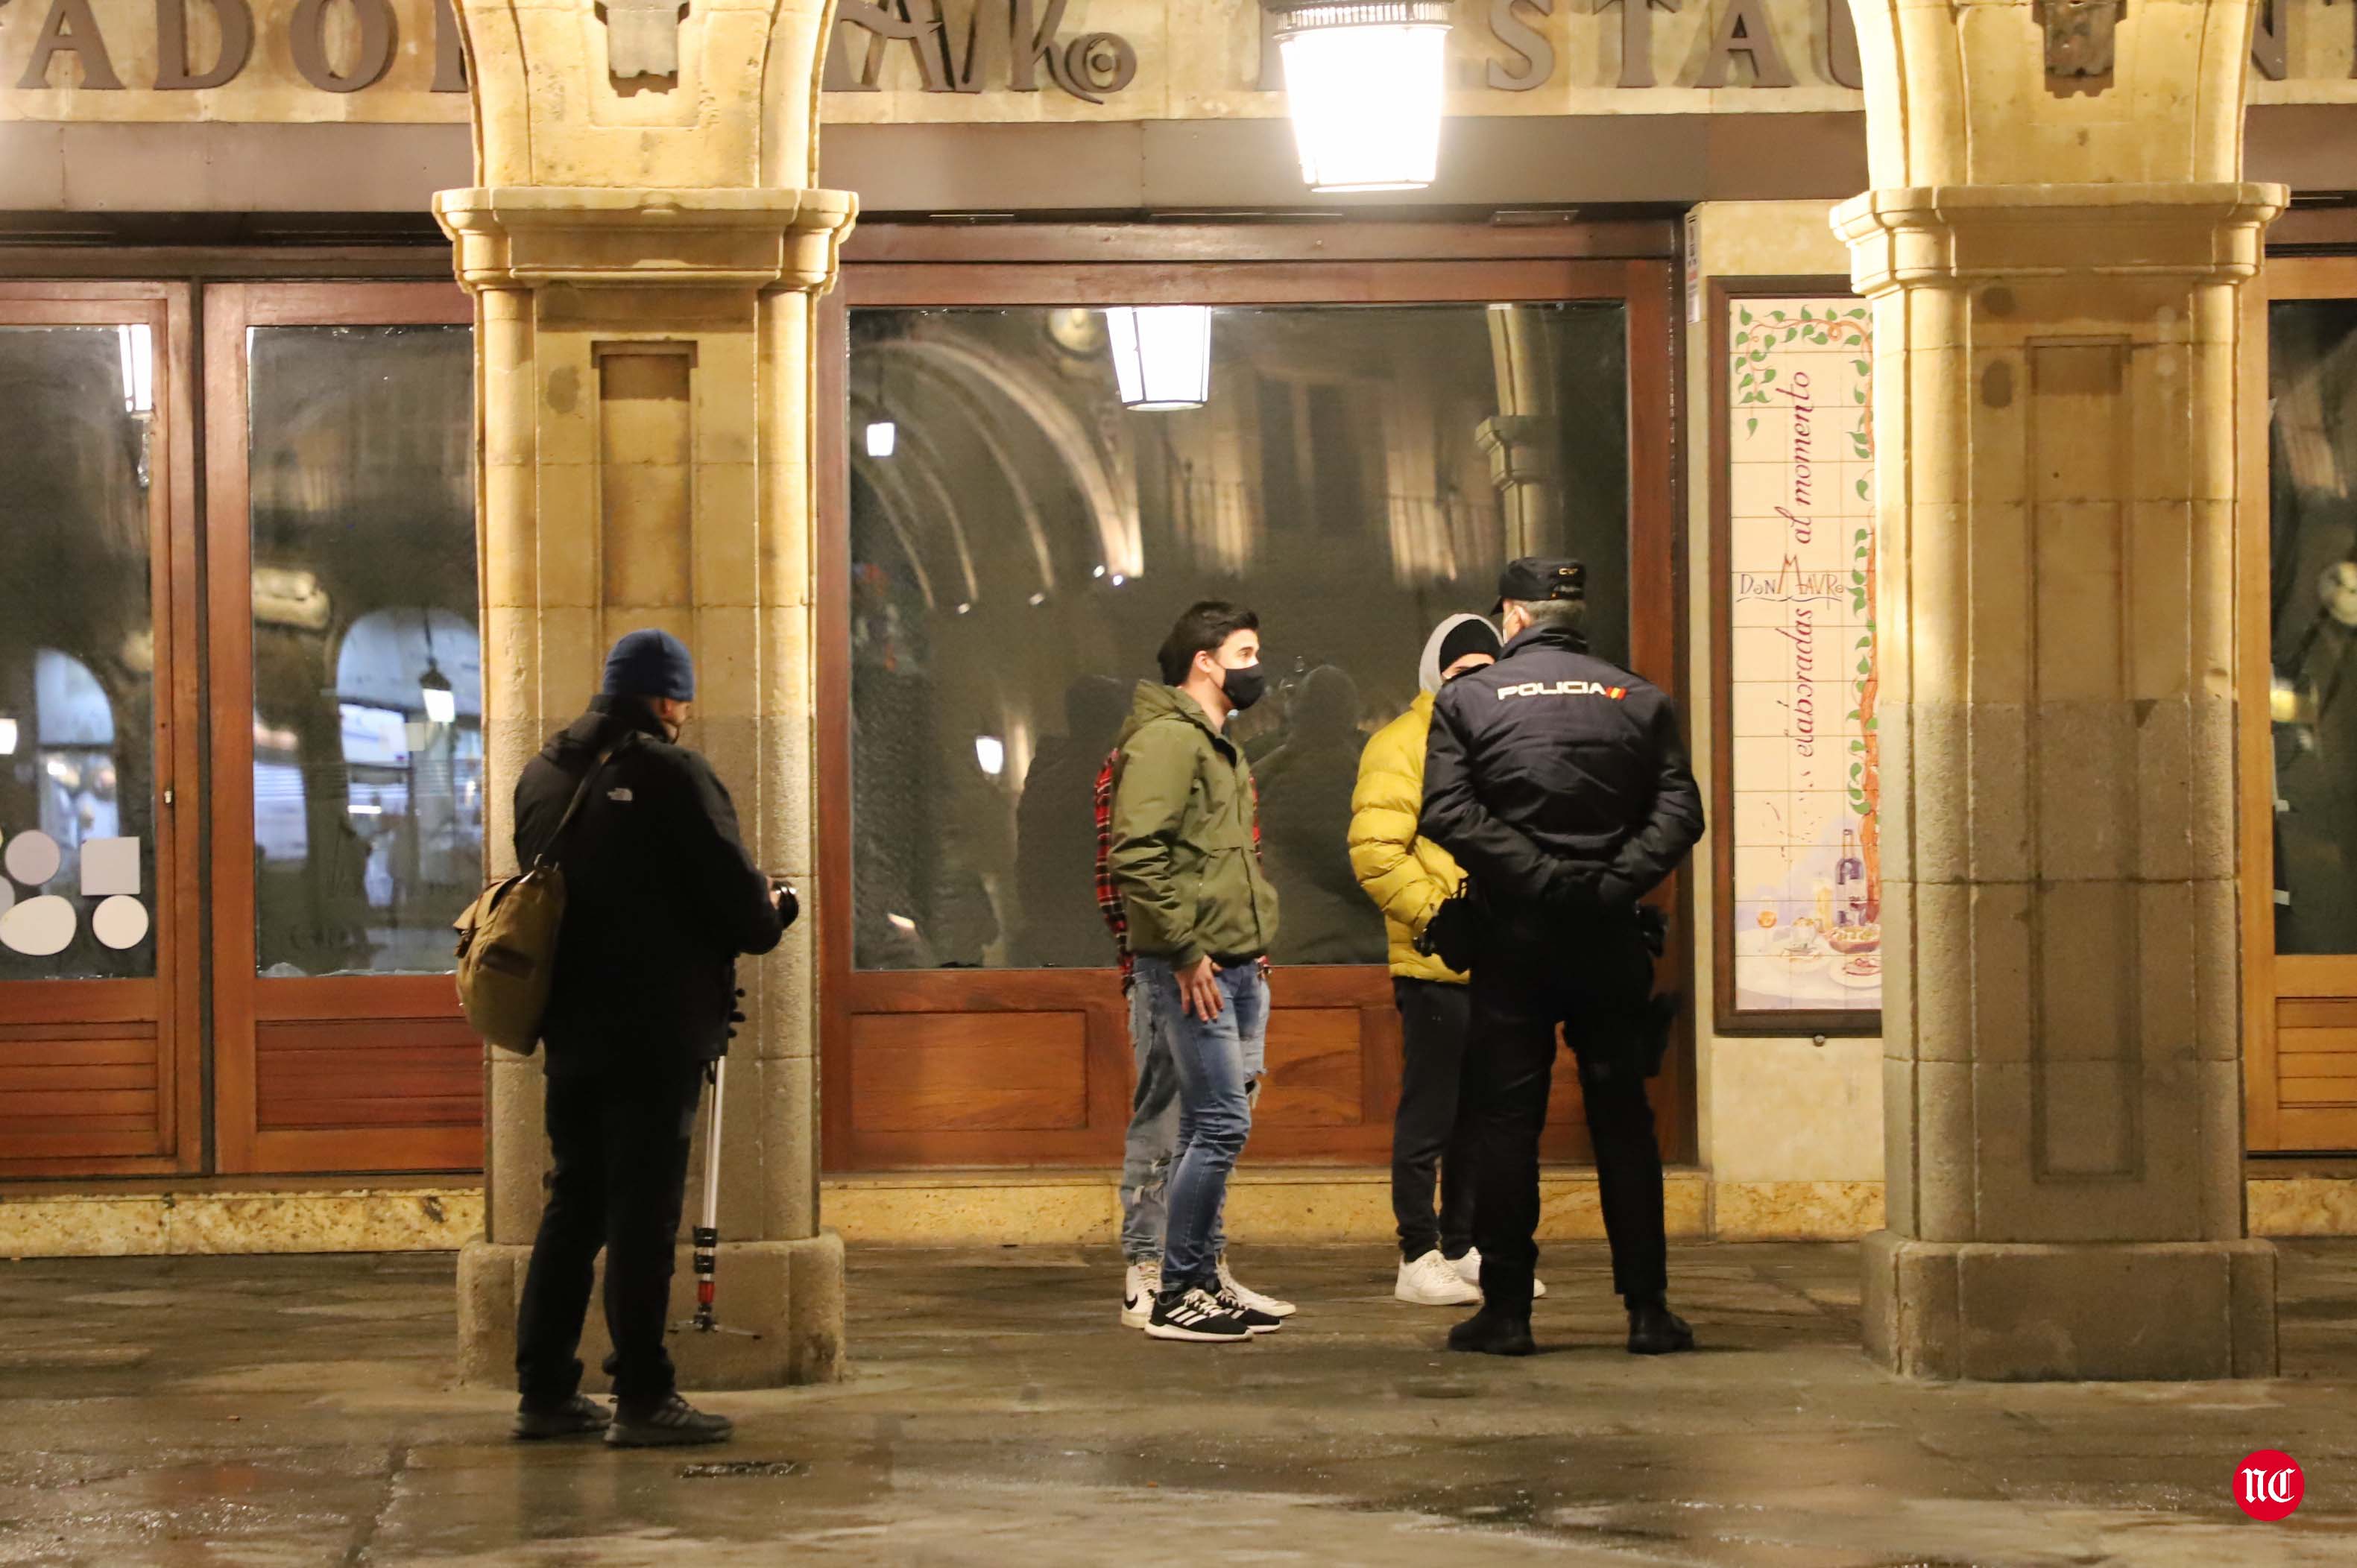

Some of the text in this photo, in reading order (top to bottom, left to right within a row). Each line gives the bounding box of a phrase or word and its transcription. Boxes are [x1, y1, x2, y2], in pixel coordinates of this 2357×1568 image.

[0, 0, 470, 93] ADO
[1775, 371, 1814, 506] momento
[1773, 506, 1812, 544] al
[1497, 680, 1607, 701] POLICIA
